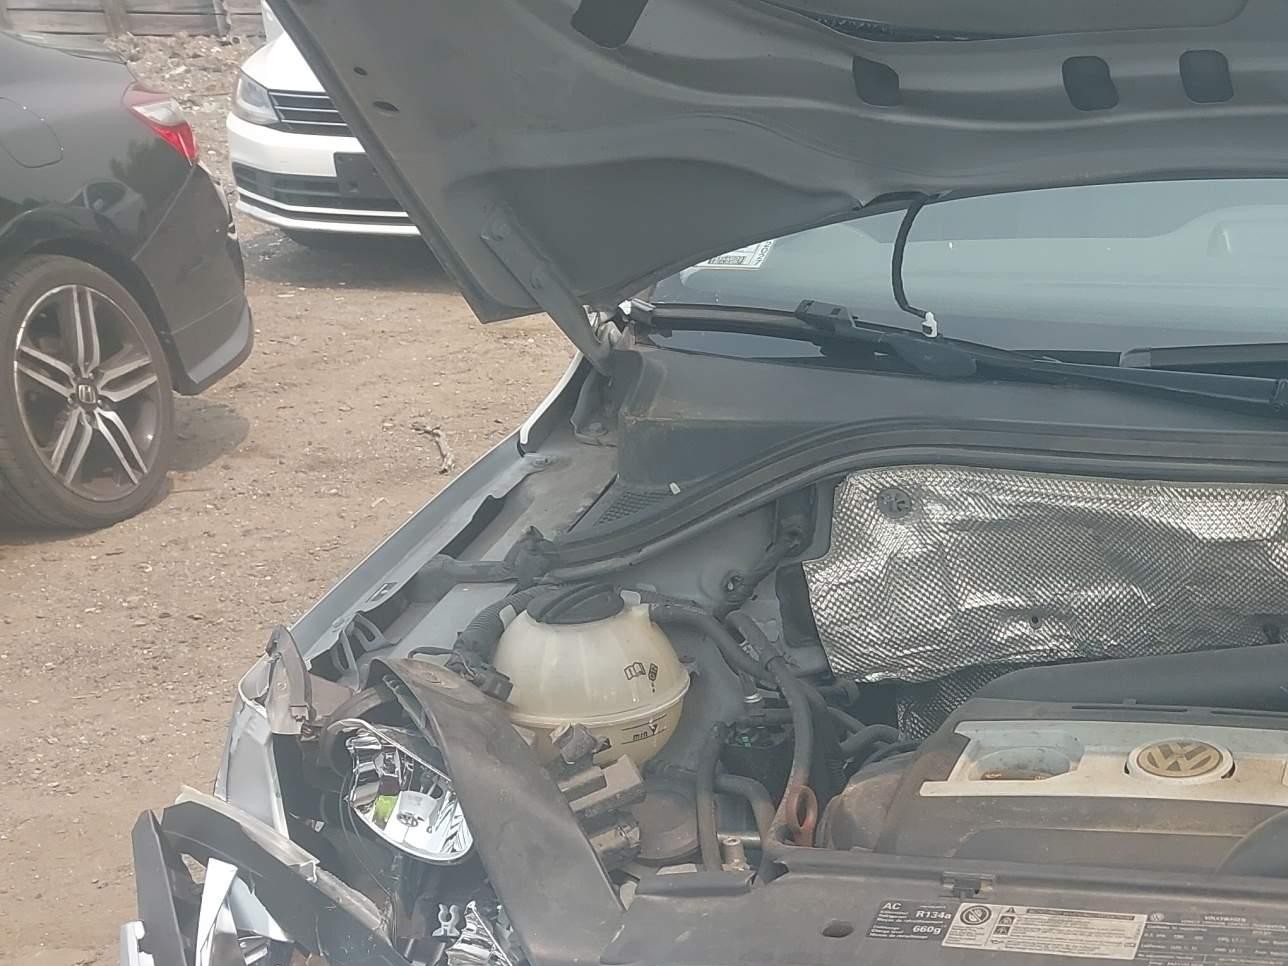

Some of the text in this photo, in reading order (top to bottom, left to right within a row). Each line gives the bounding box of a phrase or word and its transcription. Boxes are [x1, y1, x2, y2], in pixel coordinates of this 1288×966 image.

[632, 731, 648, 741] min
[882, 902, 902, 910] AC
[915, 910, 952, 919] R134a
[912, 925, 942, 935] 660g
